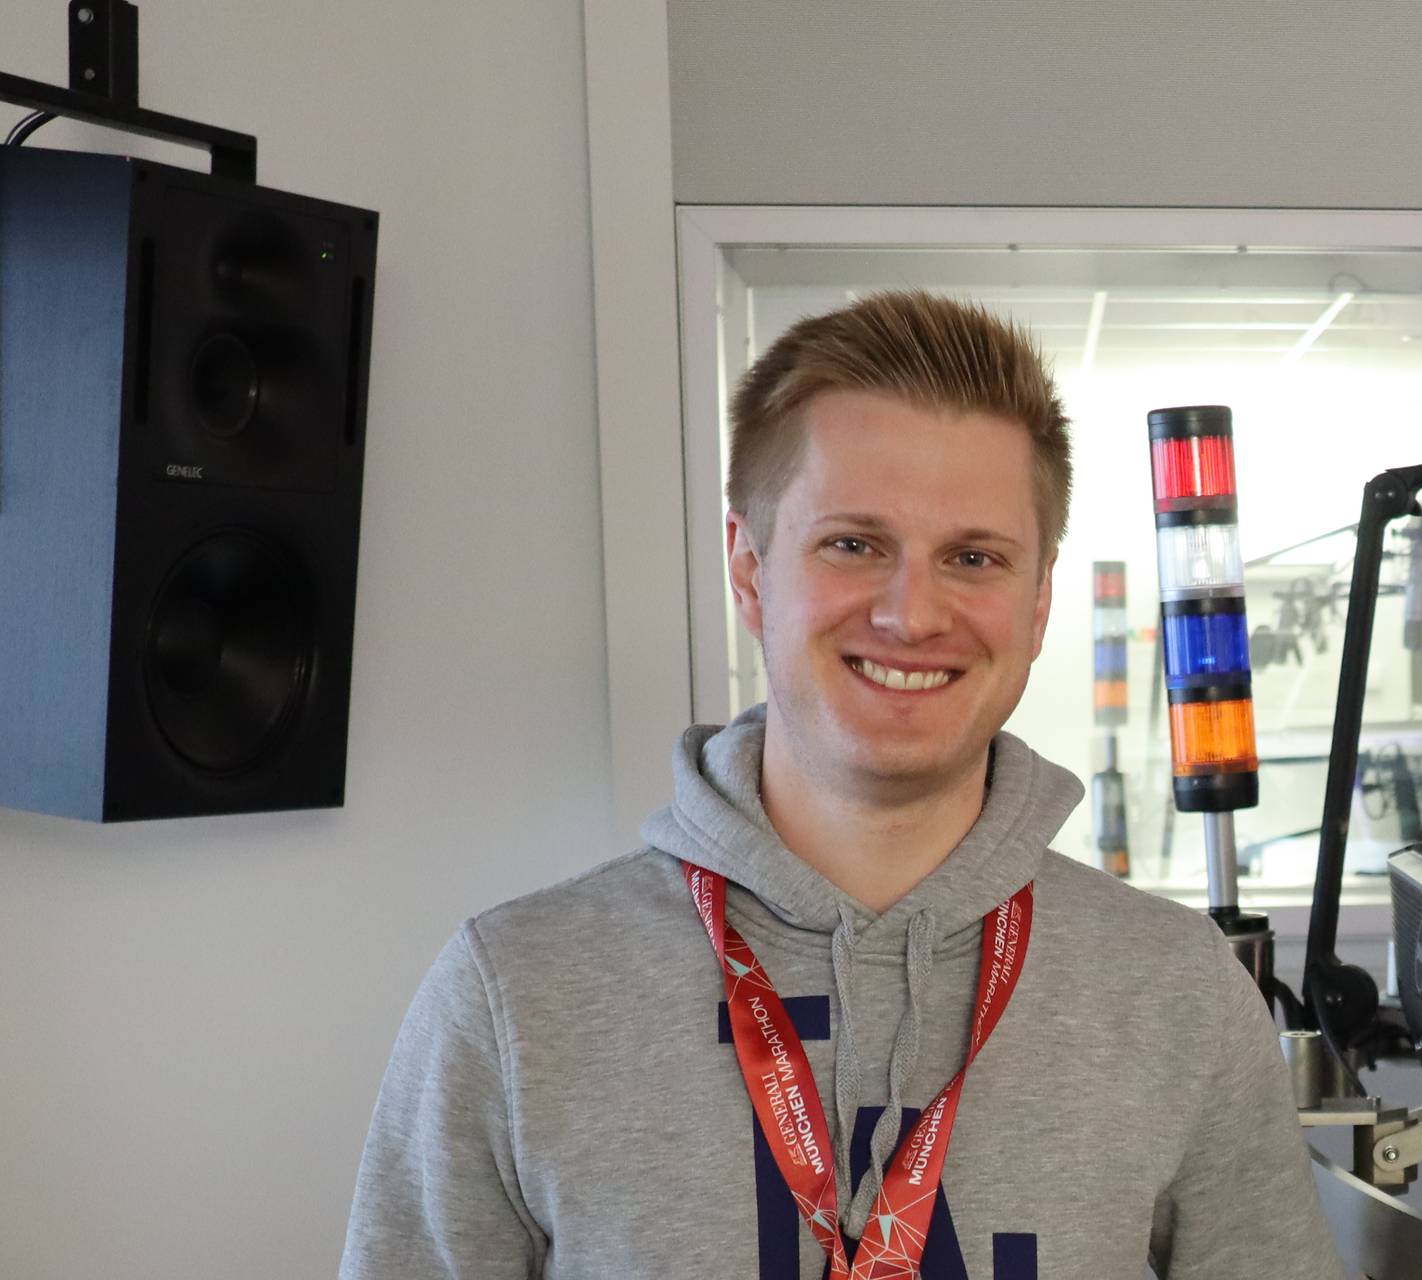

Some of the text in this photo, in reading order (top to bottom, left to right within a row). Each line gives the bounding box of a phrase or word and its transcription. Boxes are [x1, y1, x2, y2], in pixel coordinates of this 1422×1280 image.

[1000, 920, 1021, 984] GENERALI
[748, 996, 825, 1175] MÜNCHEN MARATHON
[761, 1072, 798, 1146] GENERALI
[908, 1097, 948, 1185] MÜNCHEN
